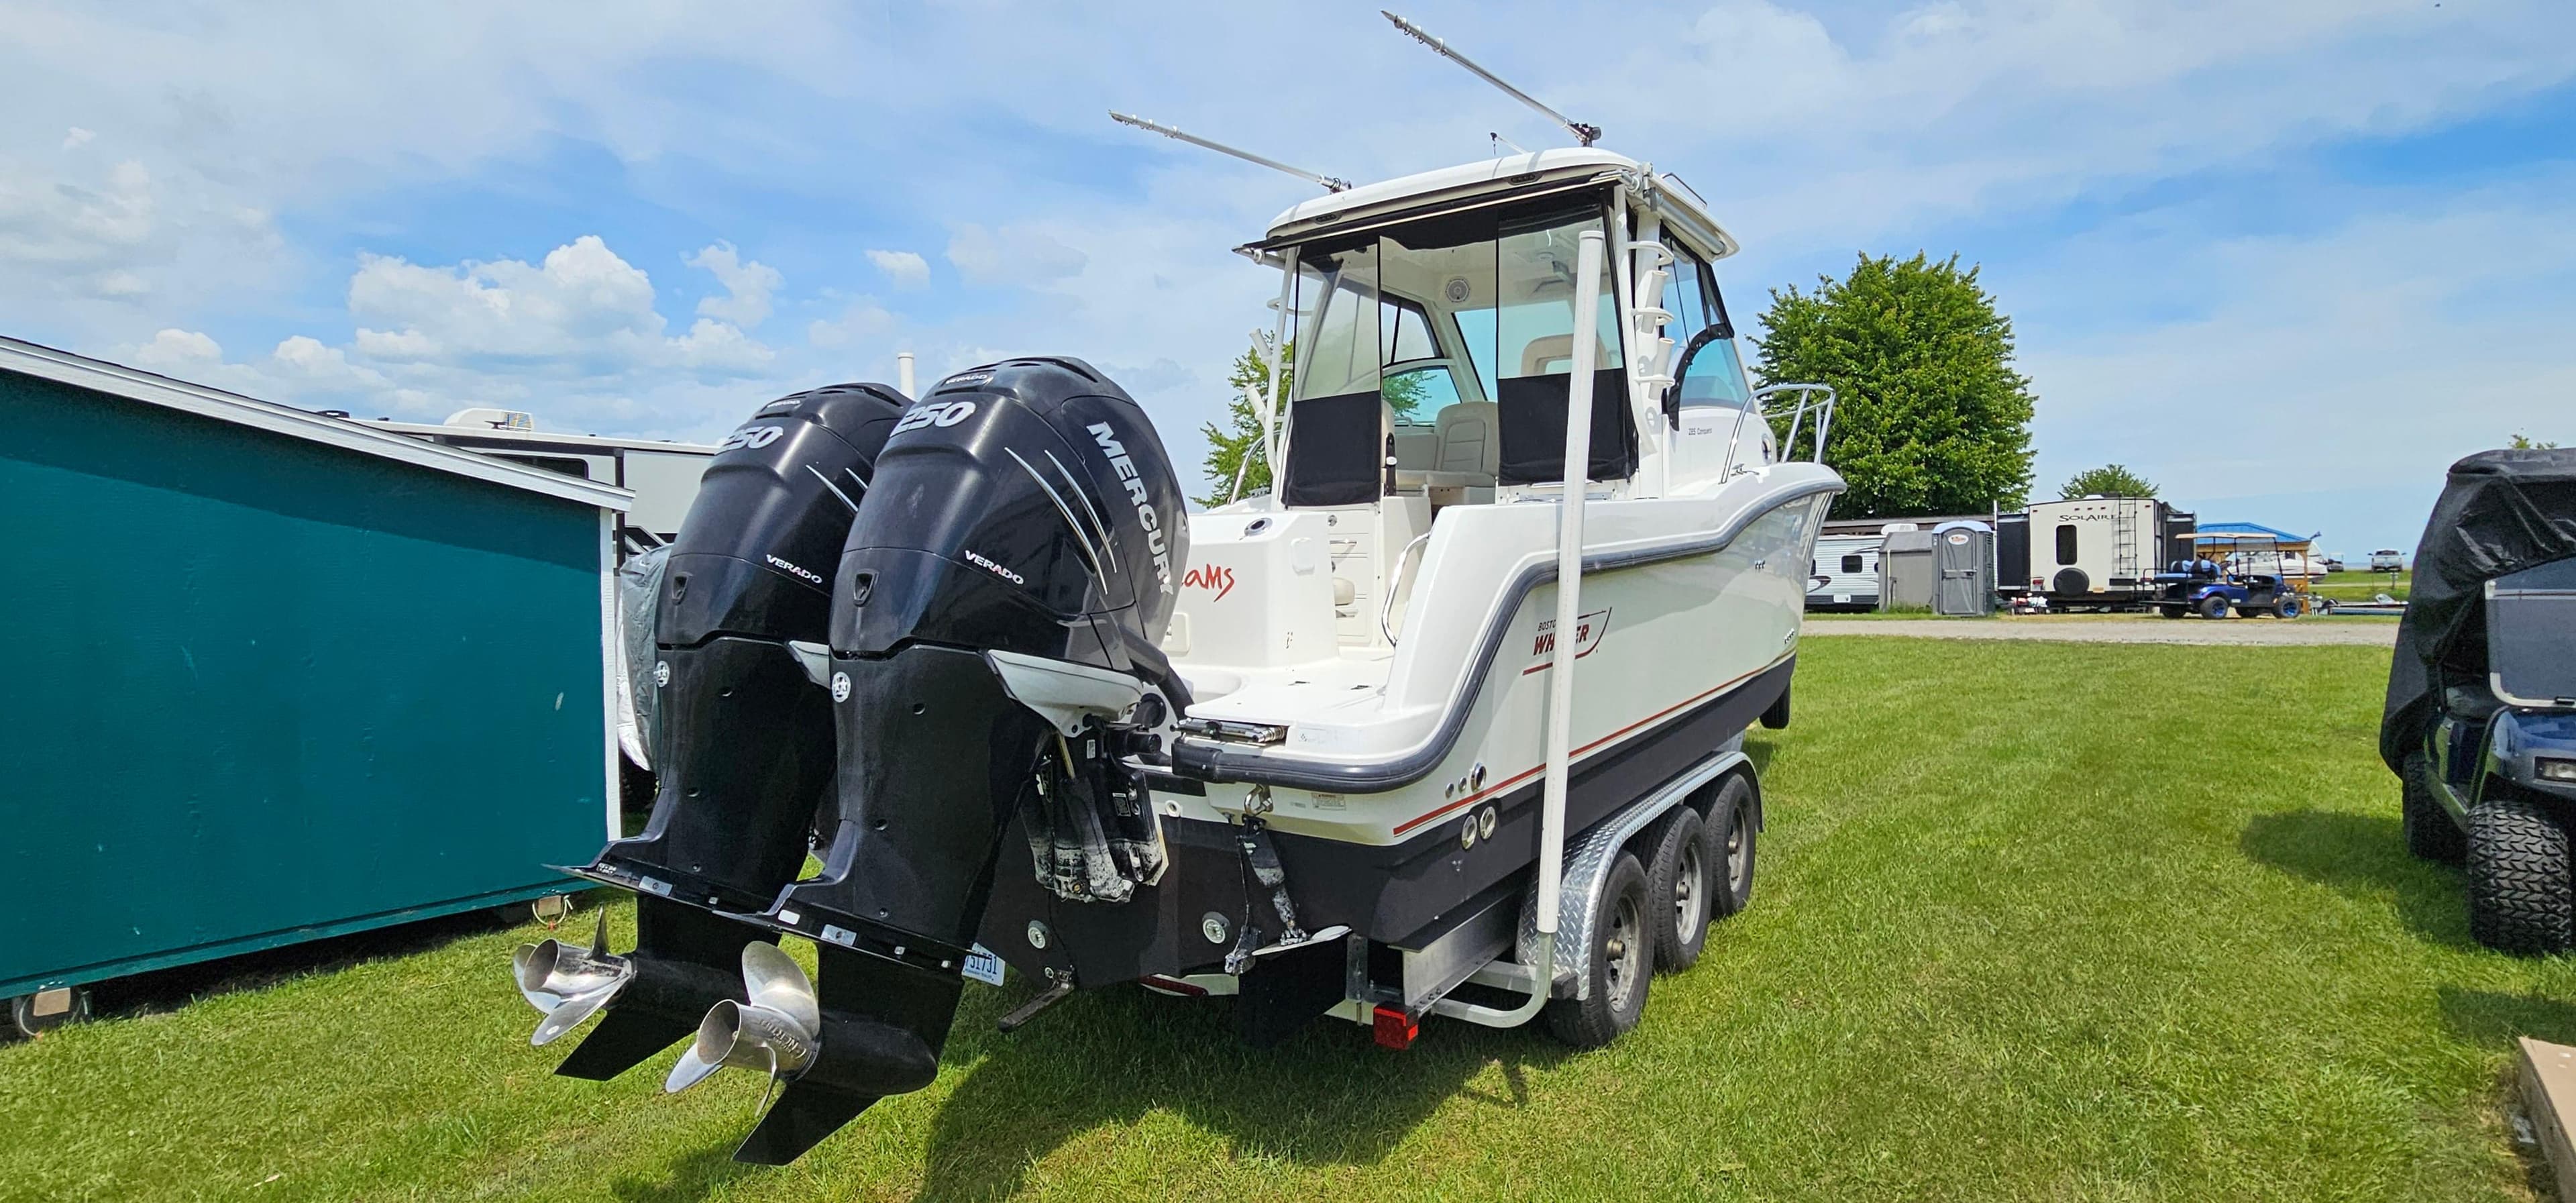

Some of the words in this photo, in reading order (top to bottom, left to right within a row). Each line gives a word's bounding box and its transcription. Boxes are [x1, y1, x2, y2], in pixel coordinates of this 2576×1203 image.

[889, 401, 977, 437] 250
[714, 426, 784, 456] 250
[1085, 421, 1174, 595] MERCURY
[766, 554, 823, 584] VERADO
[965, 550, 1024, 585] VERADO
[1533, 623, 1590, 656] WHER
[1538, 619, 1556, 631] BOSTO
